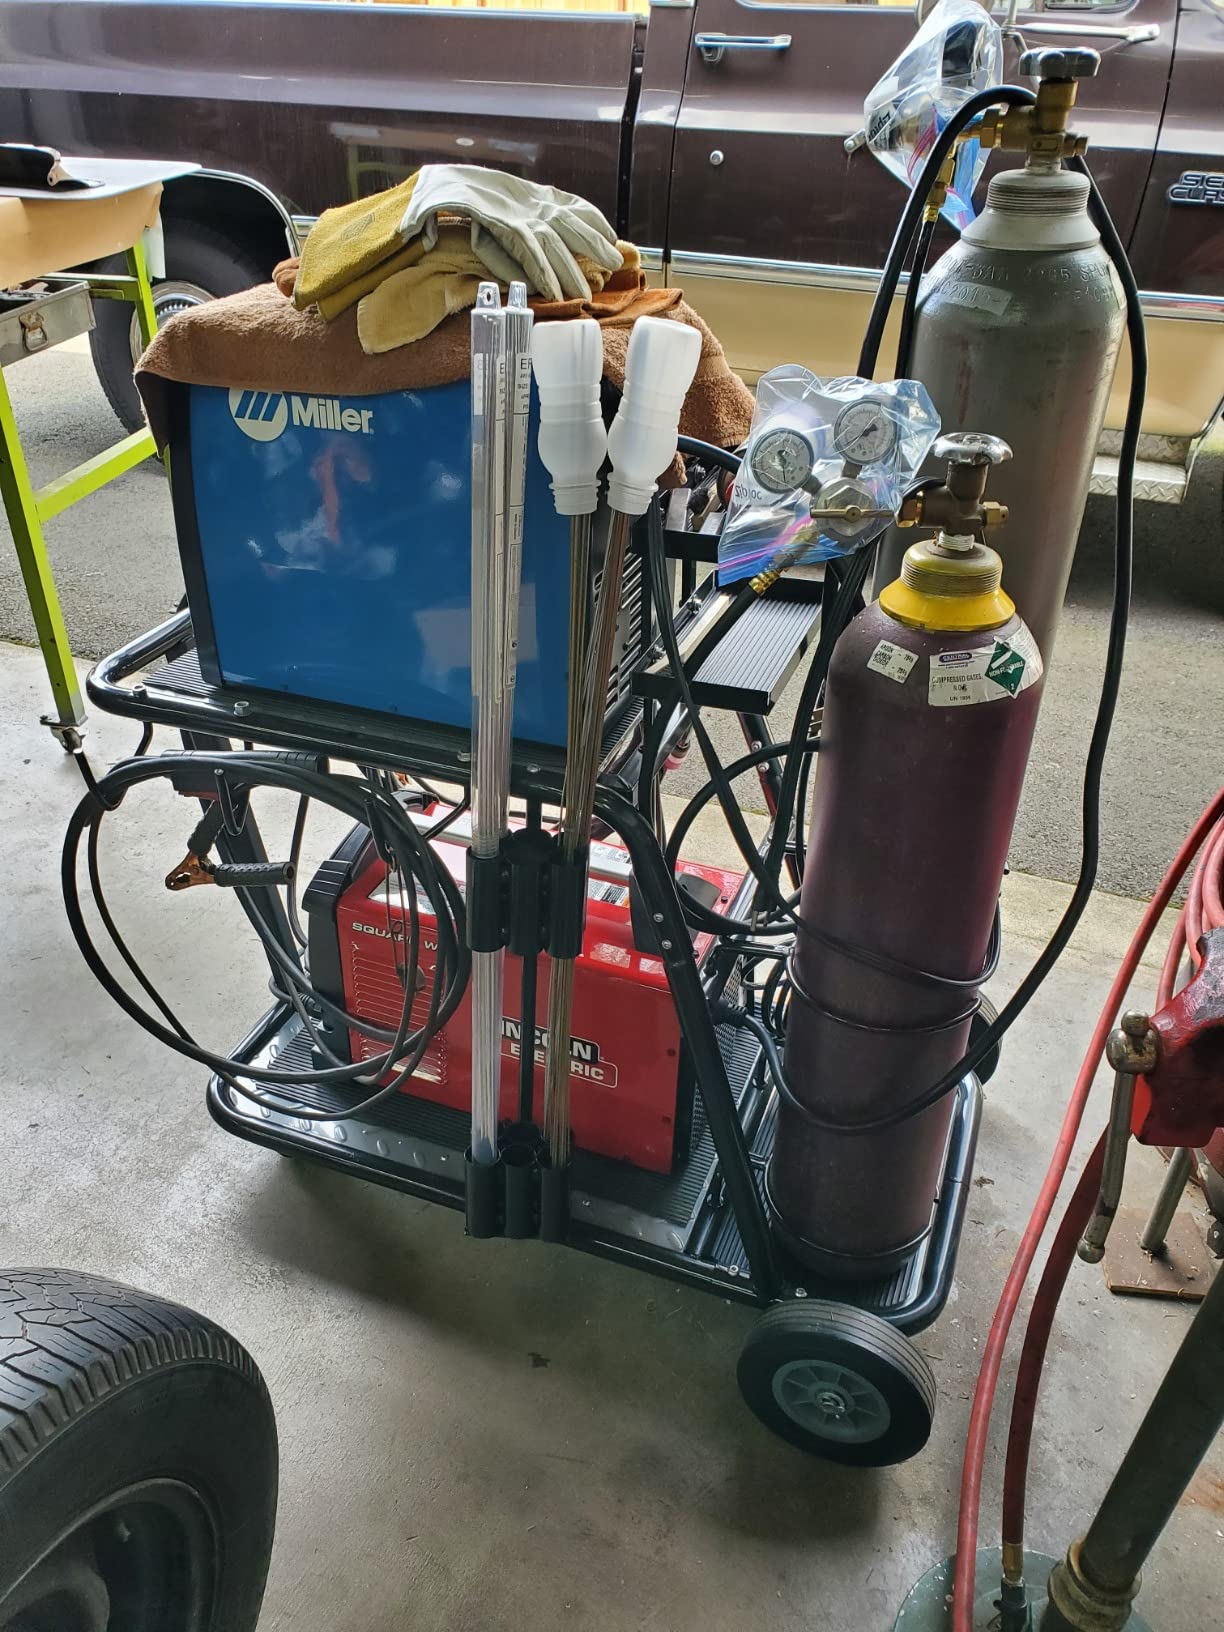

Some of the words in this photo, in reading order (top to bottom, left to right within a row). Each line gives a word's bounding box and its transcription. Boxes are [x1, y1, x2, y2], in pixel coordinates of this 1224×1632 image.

[1182, 172, 1224, 188] SIE
[291, 395, 374, 434] Miller
[352, 922, 412, 944] SQUAR
[510, 1042, 605, 1081] EERIC
